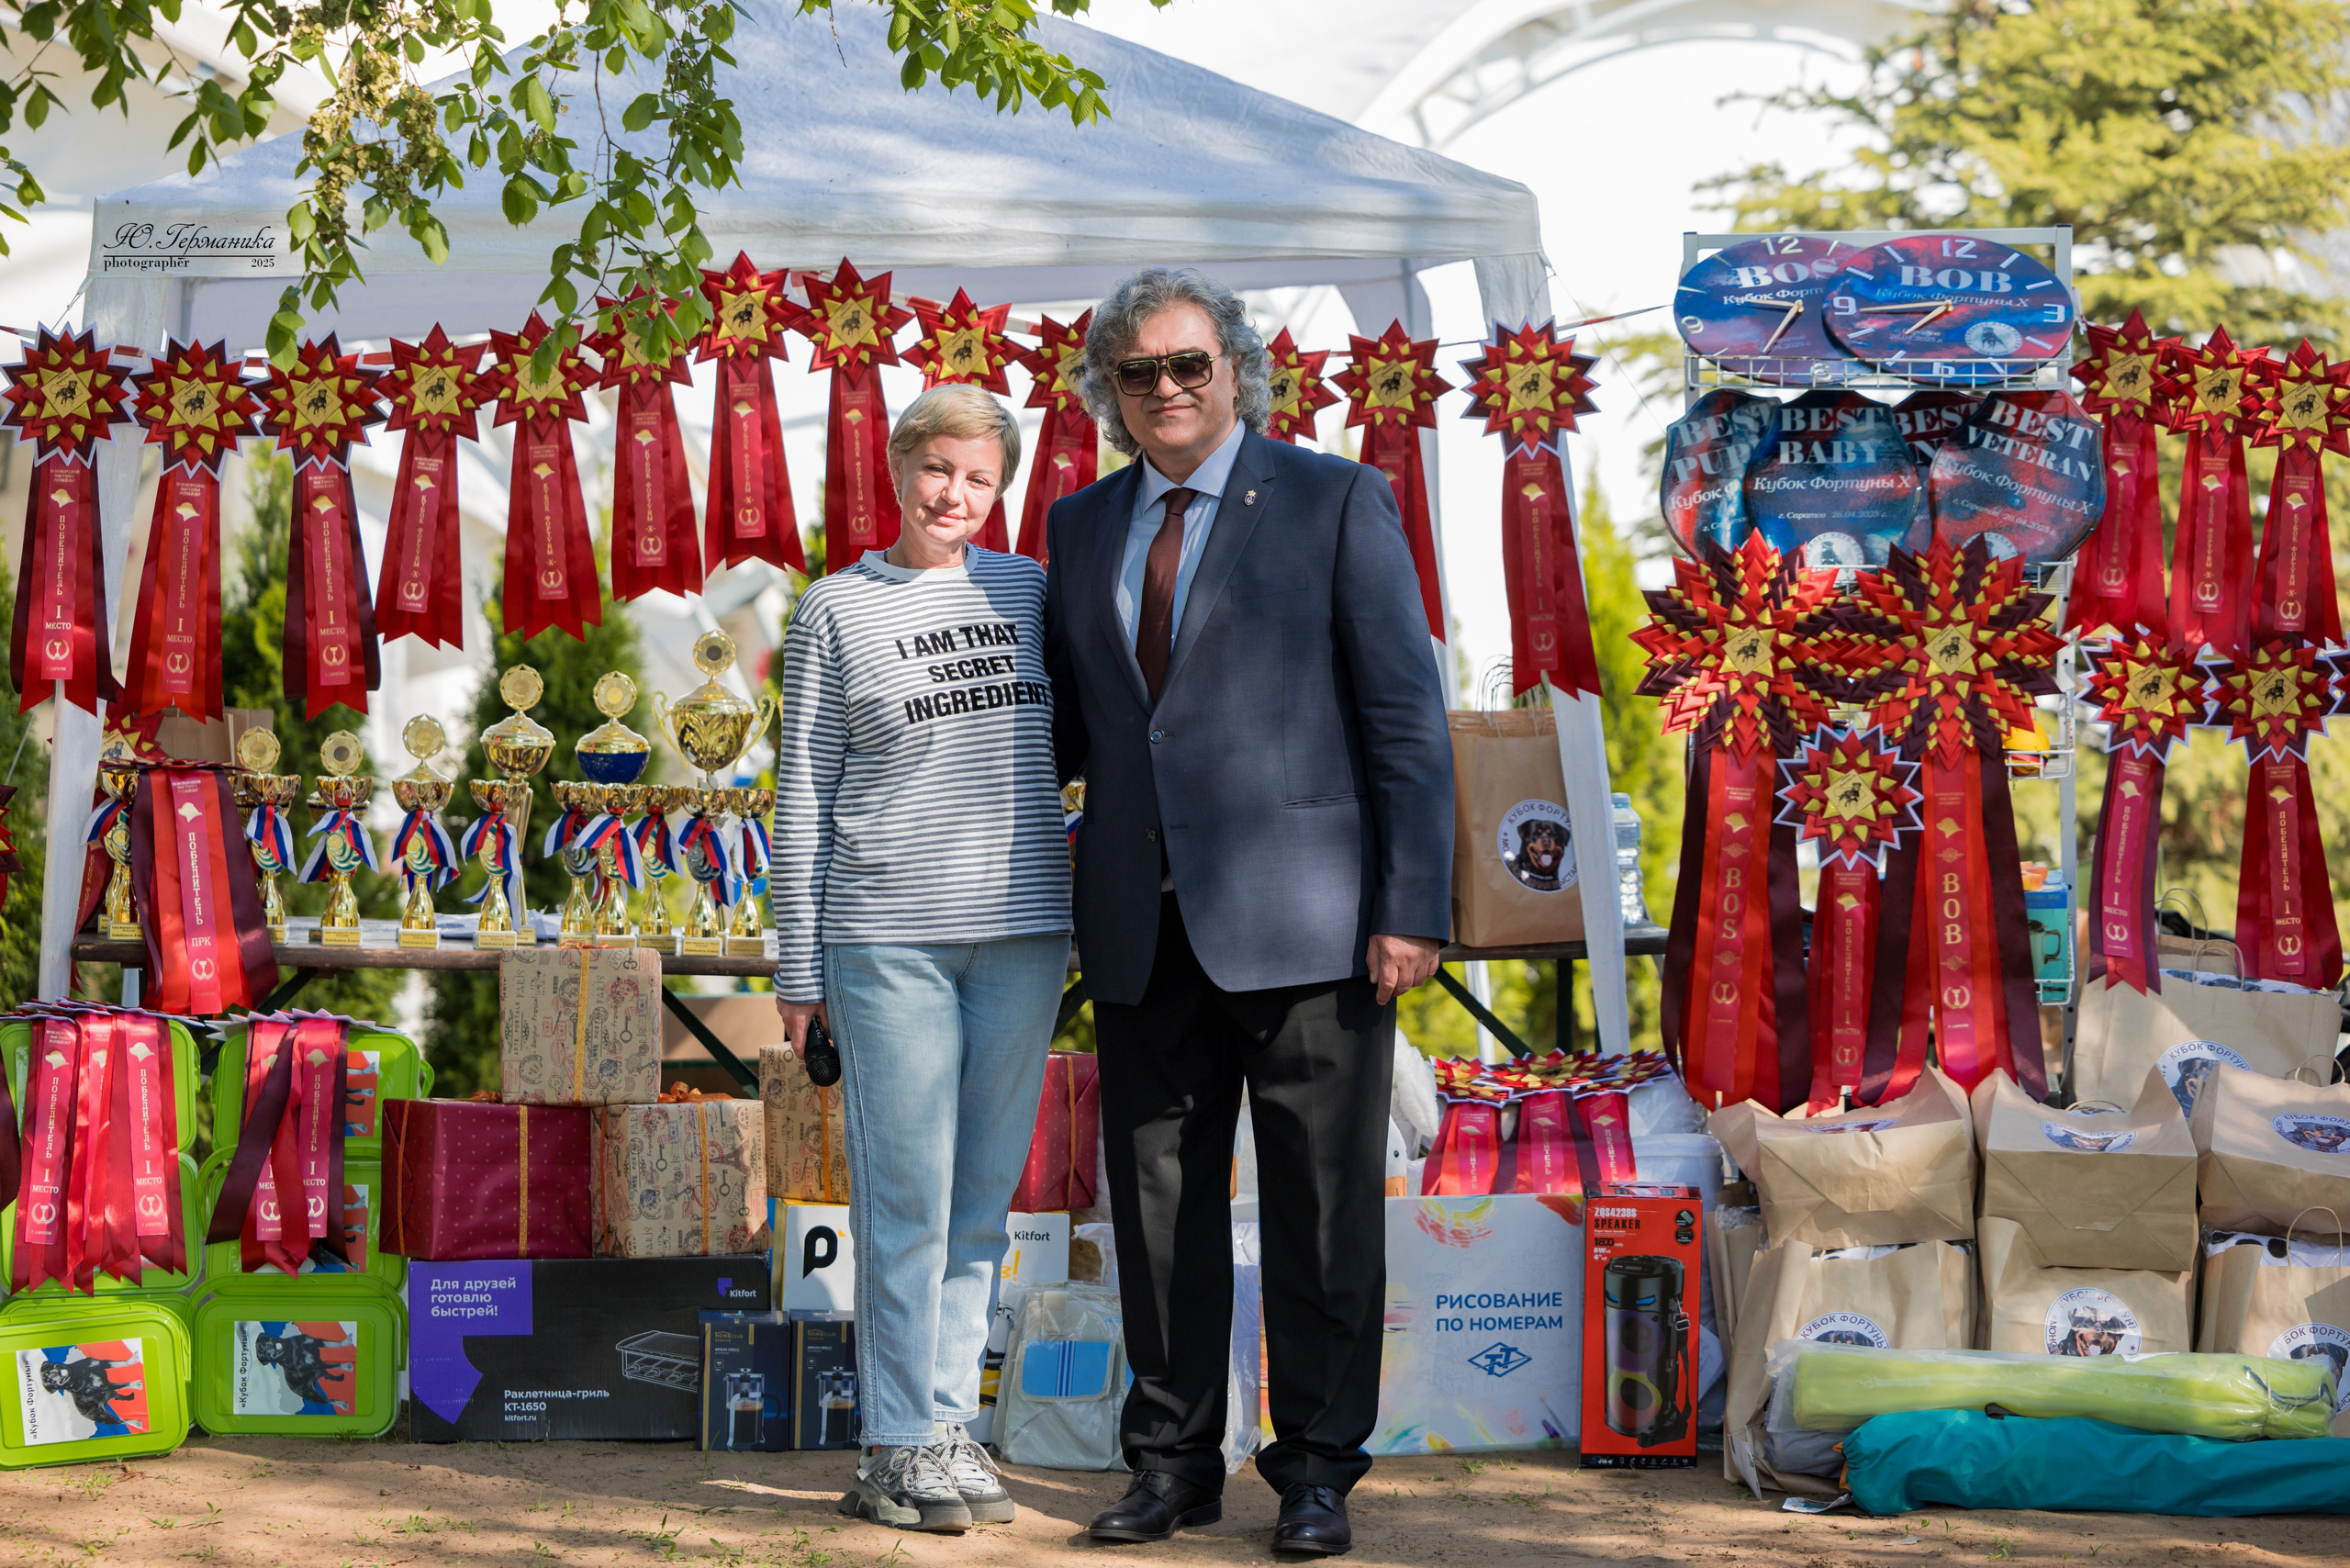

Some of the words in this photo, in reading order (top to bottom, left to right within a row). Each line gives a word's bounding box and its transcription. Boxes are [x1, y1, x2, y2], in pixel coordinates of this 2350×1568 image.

[1761, 235, 1804, 256] 12
[1942, 238, 1978, 259] 12
[1731, 258, 1838, 289] BOS
[1898, 265, 2013, 293] BOB
[1775, 286, 1827, 300] Форт
[1875, 287, 1927, 302] Кубок
[1833, 296, 1857, 316] 9
[2043, 303, 2065, 323] 3
[1681, 315, 1704, 334] 9
[1781, 407, 1884, 431] BEST
[1987, 398, 2095, 451] BEST
[1673, 442, 1753, 483] PUP
[1777, 440, 1882, 465] BABY
[1967, 425, 2097, 482] VETERAN
[1753, 476, 1807, 493] Кубок
[1810, 476, 1895, 492] Фортуны
[1995, 474, 2077, 510] Фортуны
[1671, 487, 1722, 510] Кубок
[1961, 498, 2001, 516] Саратов
[1786, 511, 1827, 521] Саратов
[56, 515, 65, 596] ПОБЕДИТЕЛЬ
[322, 521, 334, 601] ПОБЕДИТЕЛЬ
[178, 528, 190, 609] ПОБЕДИТЕЛЬ
[45, 622, 72, 631] МЕСТО
[319, 626, 346, 636] МЕСТО
[166, 634, 193, 643] МЕСТО
[894, 639, 909, 660] I
[913, 629, 957, 657] AM
[958, 623, 1020, 648] THAT
[927, 655, 1016, 683] SECRET
[904, 681, 1049, 725] INGREDIENT
[1506, 802, 1536, 824] КУБОК
[1538, 803, 1572, 828] ФОРТУ
[2114, 805, 2132, 884] ПОБЕДИТЕЛЬ
[2278, 811, 2290, 891] ПОБЕДИТЕЛЬ
[188, 832, 204, 926] ПОБЕДИТЕЛЬ
[1720, 867, 1742, 940] BOS
[1942, 871, 1964, 946] BOB
[2103, 905, 2129, 917] МЕСТО
[2275, 917, 2301, 925] МЕСТО
[191, 936, 212, 947] ПРК
[1844, 919, 1852, 1001] ПОБЕДИТЕЛЬ
[516, 969, 526, 998] PARIS
[1835, 1027, 1860, 1036] МЕСТО
[2168, 1042, 2204, 1060] КУБОК
[2207, 1044, 2252, 1072] ФОРТУН
[45, 1077, 60, 1159] ПОБЕДИТЕЛЬ
[140, 1069, 151, 1150] ПОБЕДИТЕЛЬ
[310, 1074, 321, 1152] ПОБЕДИТЕЛЬ
[32, 1184, 59, 1194] МЕСТО
[136, 1177, 162, 1185] МЕСТО
[258, 1182, 275, 1190] МЕС
[1594, 1218, 1641, 1229] SPEAKER
[1014, 1230, 1051, 1241] Kitfort
[431, 1278, 459, 1291] Для
[464, 1276, 517, 1292] друзей
[730, 1288, 756, 1298] Kitfort
[431, 1293, 492, 1305] готовлю
[1436, 1292, 1563, 1310] РИСОВАНИЕ
[431, 1304, 498, 1318] быстрей!
[1436, 1317, 1464, 1332] ПО
[1470, 1316, 1563, 1331] НОМЕРАМ
[1800, 1315, 1836, 1339] КУБОК
[239, 1329, 249, 1374] Фортуны»
[25, 1360, 36, 1406] Фортуны»
[239, 1376, 249, 1408] «Кубок
[504, 1388, 610, 1400] Раклетница-гриль
[28, 1407, 39, 1439] «Кубок
[504, 1414, 537, 1422] kitfort.ru
